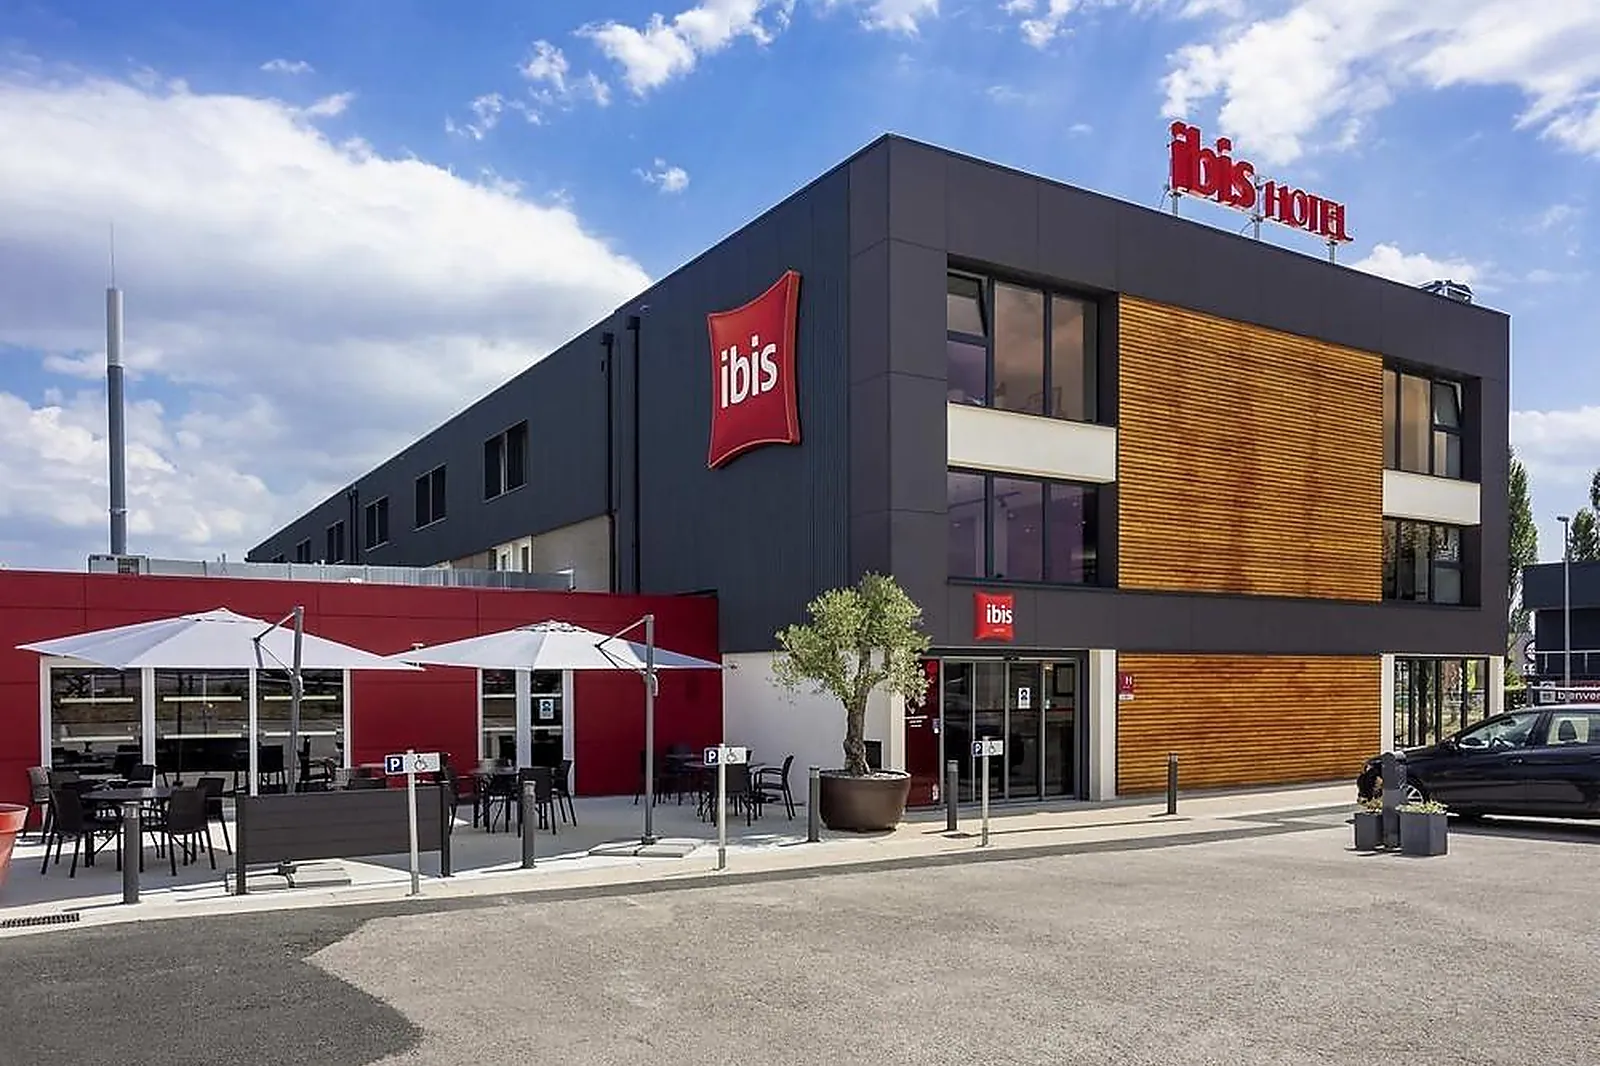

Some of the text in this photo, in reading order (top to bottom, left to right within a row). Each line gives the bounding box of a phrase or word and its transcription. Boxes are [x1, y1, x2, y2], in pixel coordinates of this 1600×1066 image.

[1170, 120, 1354, 241] ibis HOTEL
[721, 334, 778, 409] ibis
[986, 603, 1013, 624] ibis
[708, 750, 716, 763] P
[975, 743, 982, 753] P
[390, 757, 400, 771] P
